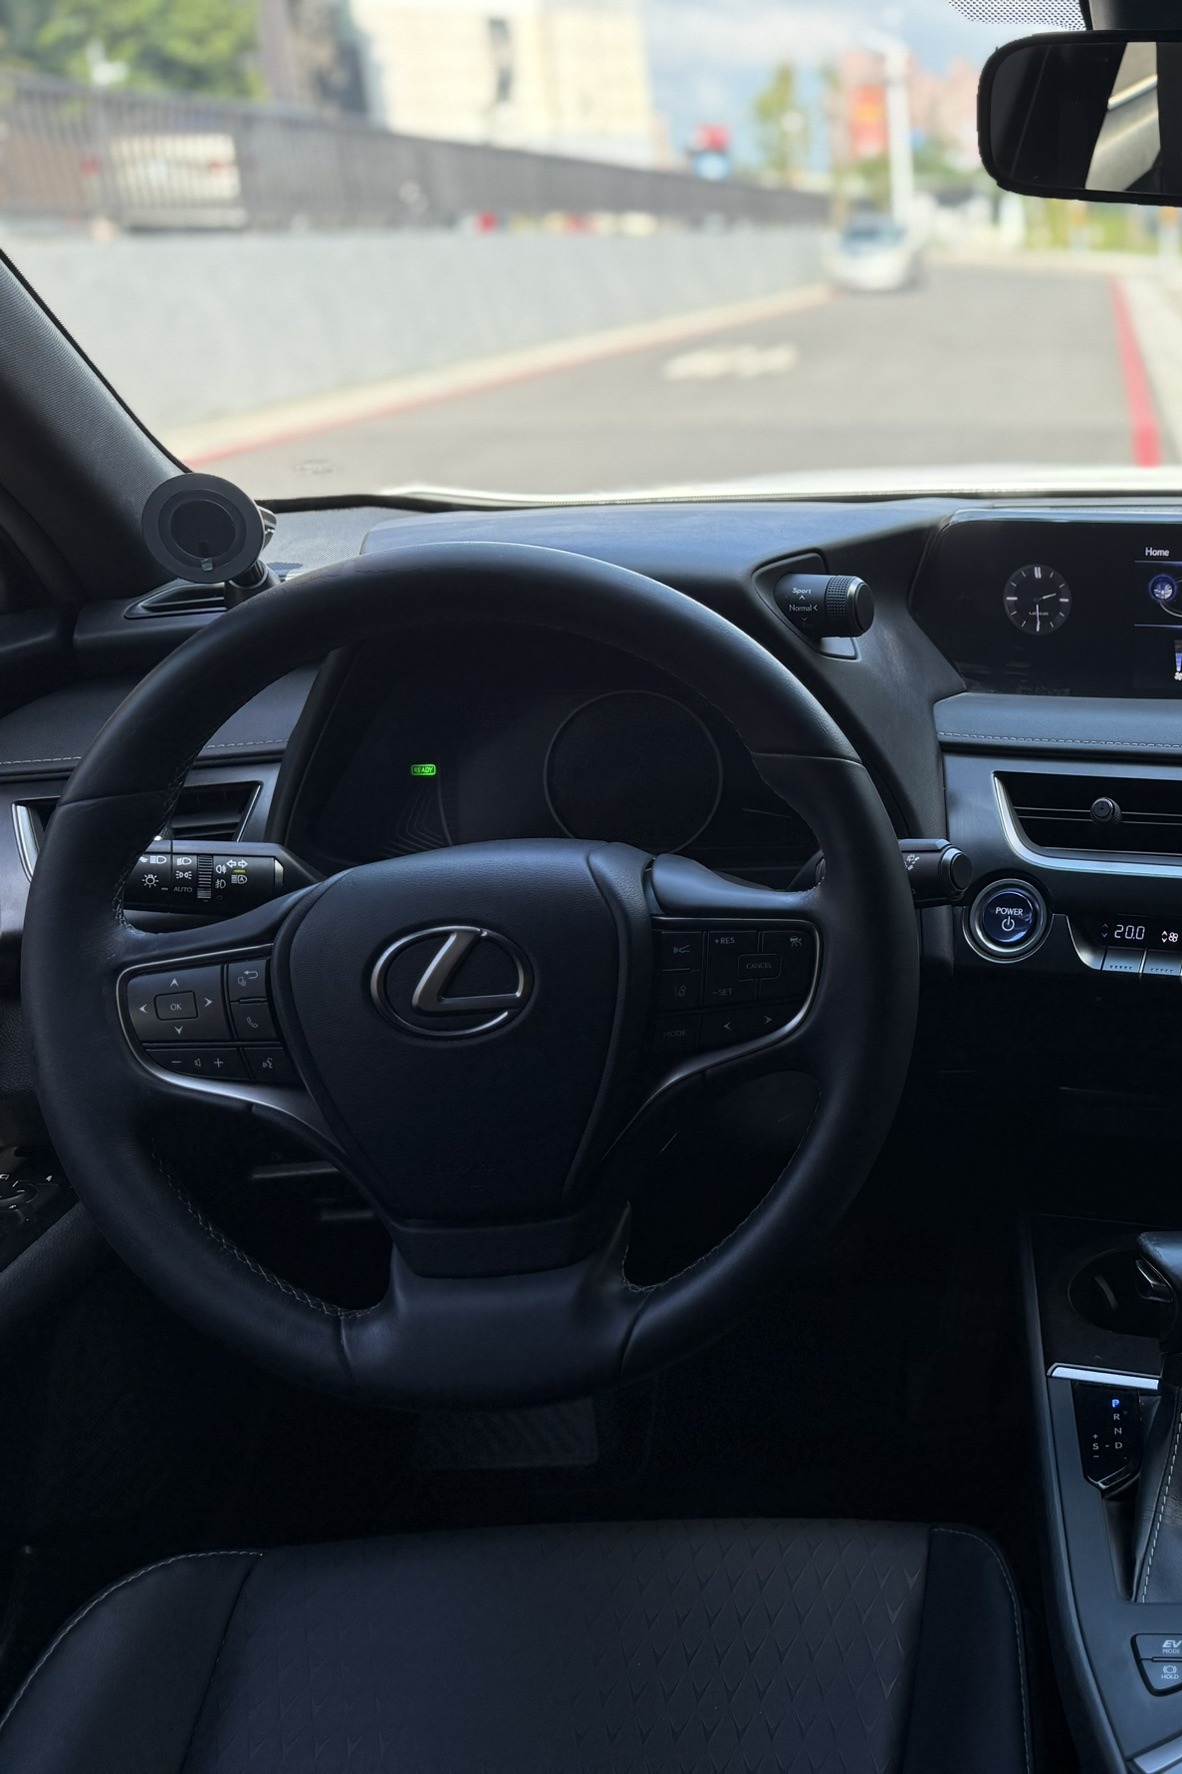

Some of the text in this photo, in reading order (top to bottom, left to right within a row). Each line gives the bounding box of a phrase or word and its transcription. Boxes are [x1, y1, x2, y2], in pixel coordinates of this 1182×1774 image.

[1145, 547, 1170, 557] Home
[792, 587, 812, 595] Sport
[789, 604, 813, 612] Normal
[995, 906, 1024, 917] POWER
[1114, 924, 1146, 941] 20.0
[745, 962, 773, 970] CANCEL
[170, 1003, 182, 1011] OK
[1111, 1399, 1120, 1408] P
[1113, 1413, 1120, 1421] R
[1114, 1427, 1122, 1435] N
[1092, 1442, 1099, 1450] S
[1161, 1639, 1182, 1648] EV
